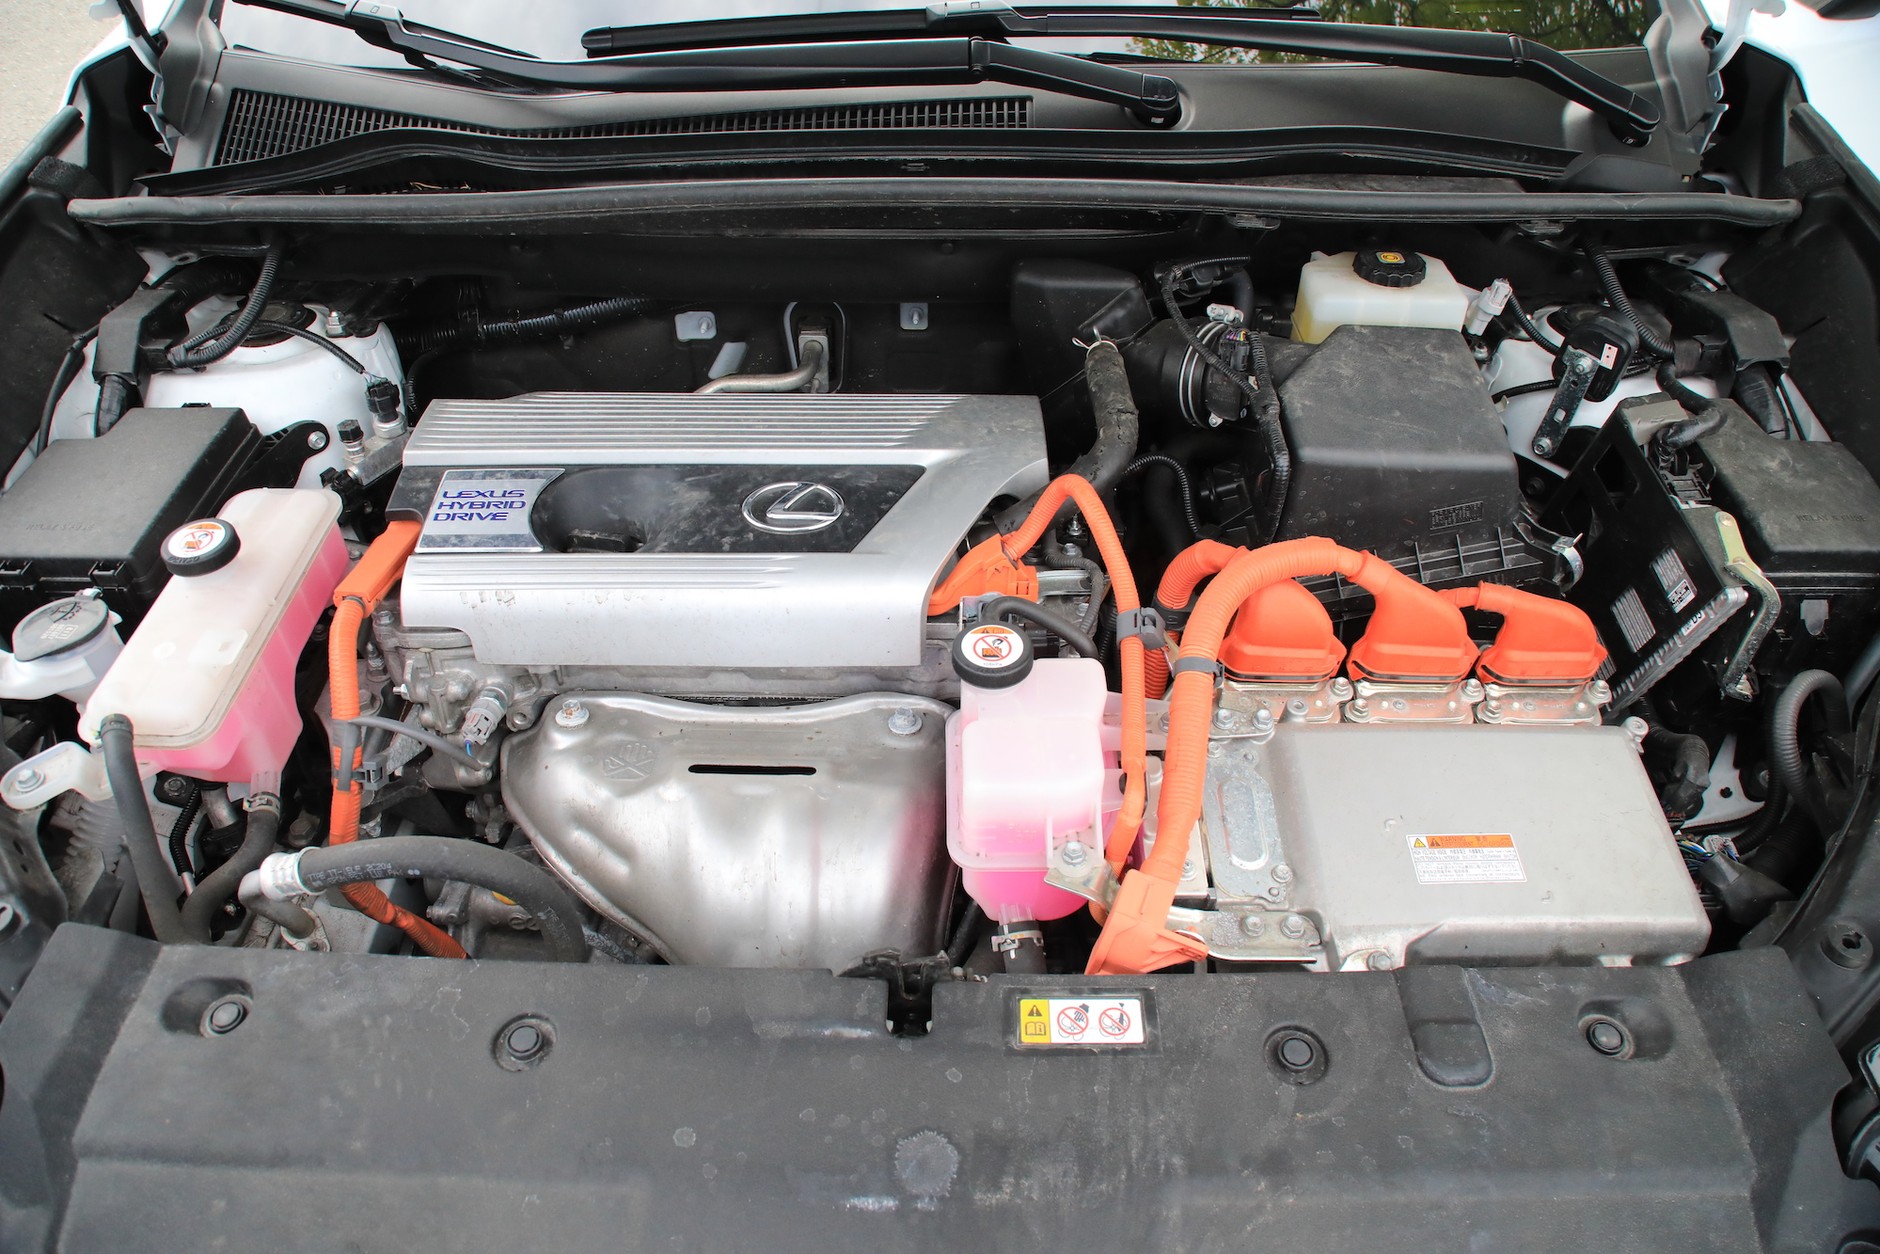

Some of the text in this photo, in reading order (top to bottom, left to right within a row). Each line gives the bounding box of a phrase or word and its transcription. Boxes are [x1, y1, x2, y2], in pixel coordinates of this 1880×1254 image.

[442, 489, 525, 499] LEXUS
[437, 500, 527, 510] HYBRID
[433, 512, 509, 521] DRIVE
